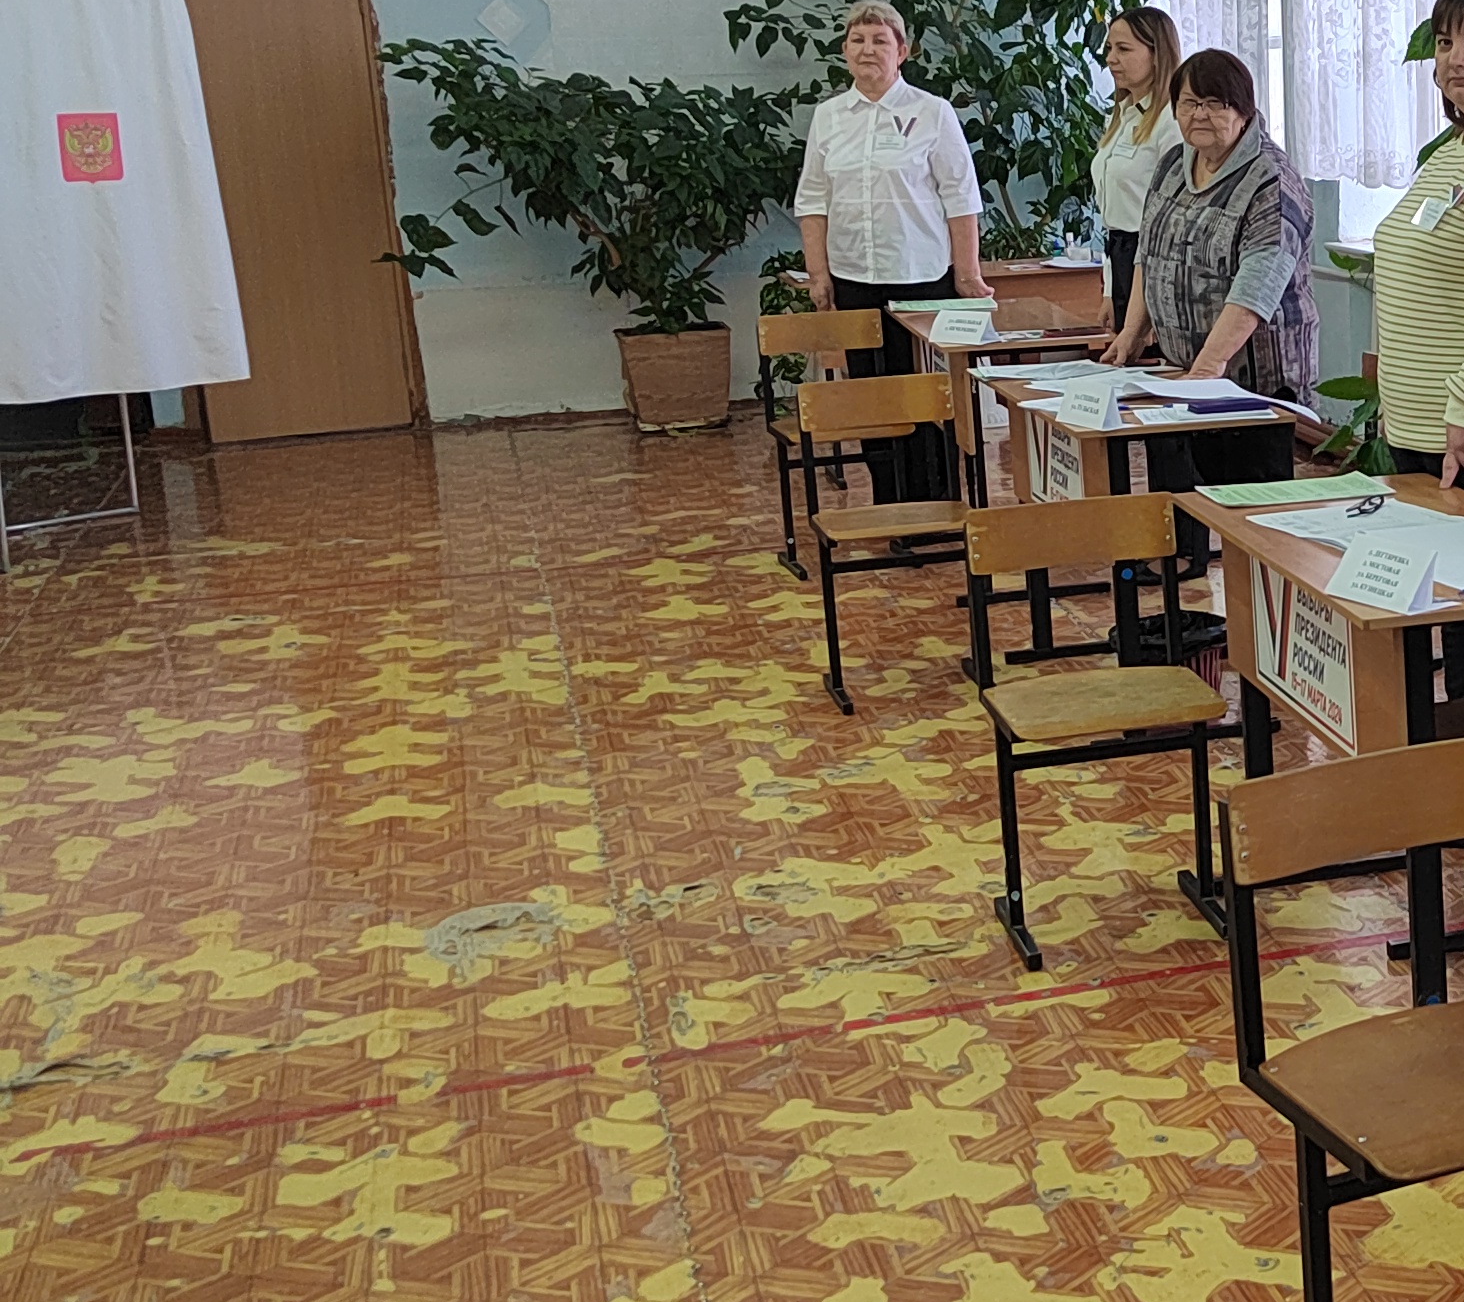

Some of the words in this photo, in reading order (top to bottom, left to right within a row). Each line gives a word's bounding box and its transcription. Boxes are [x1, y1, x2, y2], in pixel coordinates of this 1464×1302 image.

[1292, 641, 1326, 685] РОССИИ
[1294, 611, 1347, 669] ПРЕЗИДЕНТА
[1306, 682, 1327, 716] МАРТА
[1327, 697, 1343, 728] 2024
